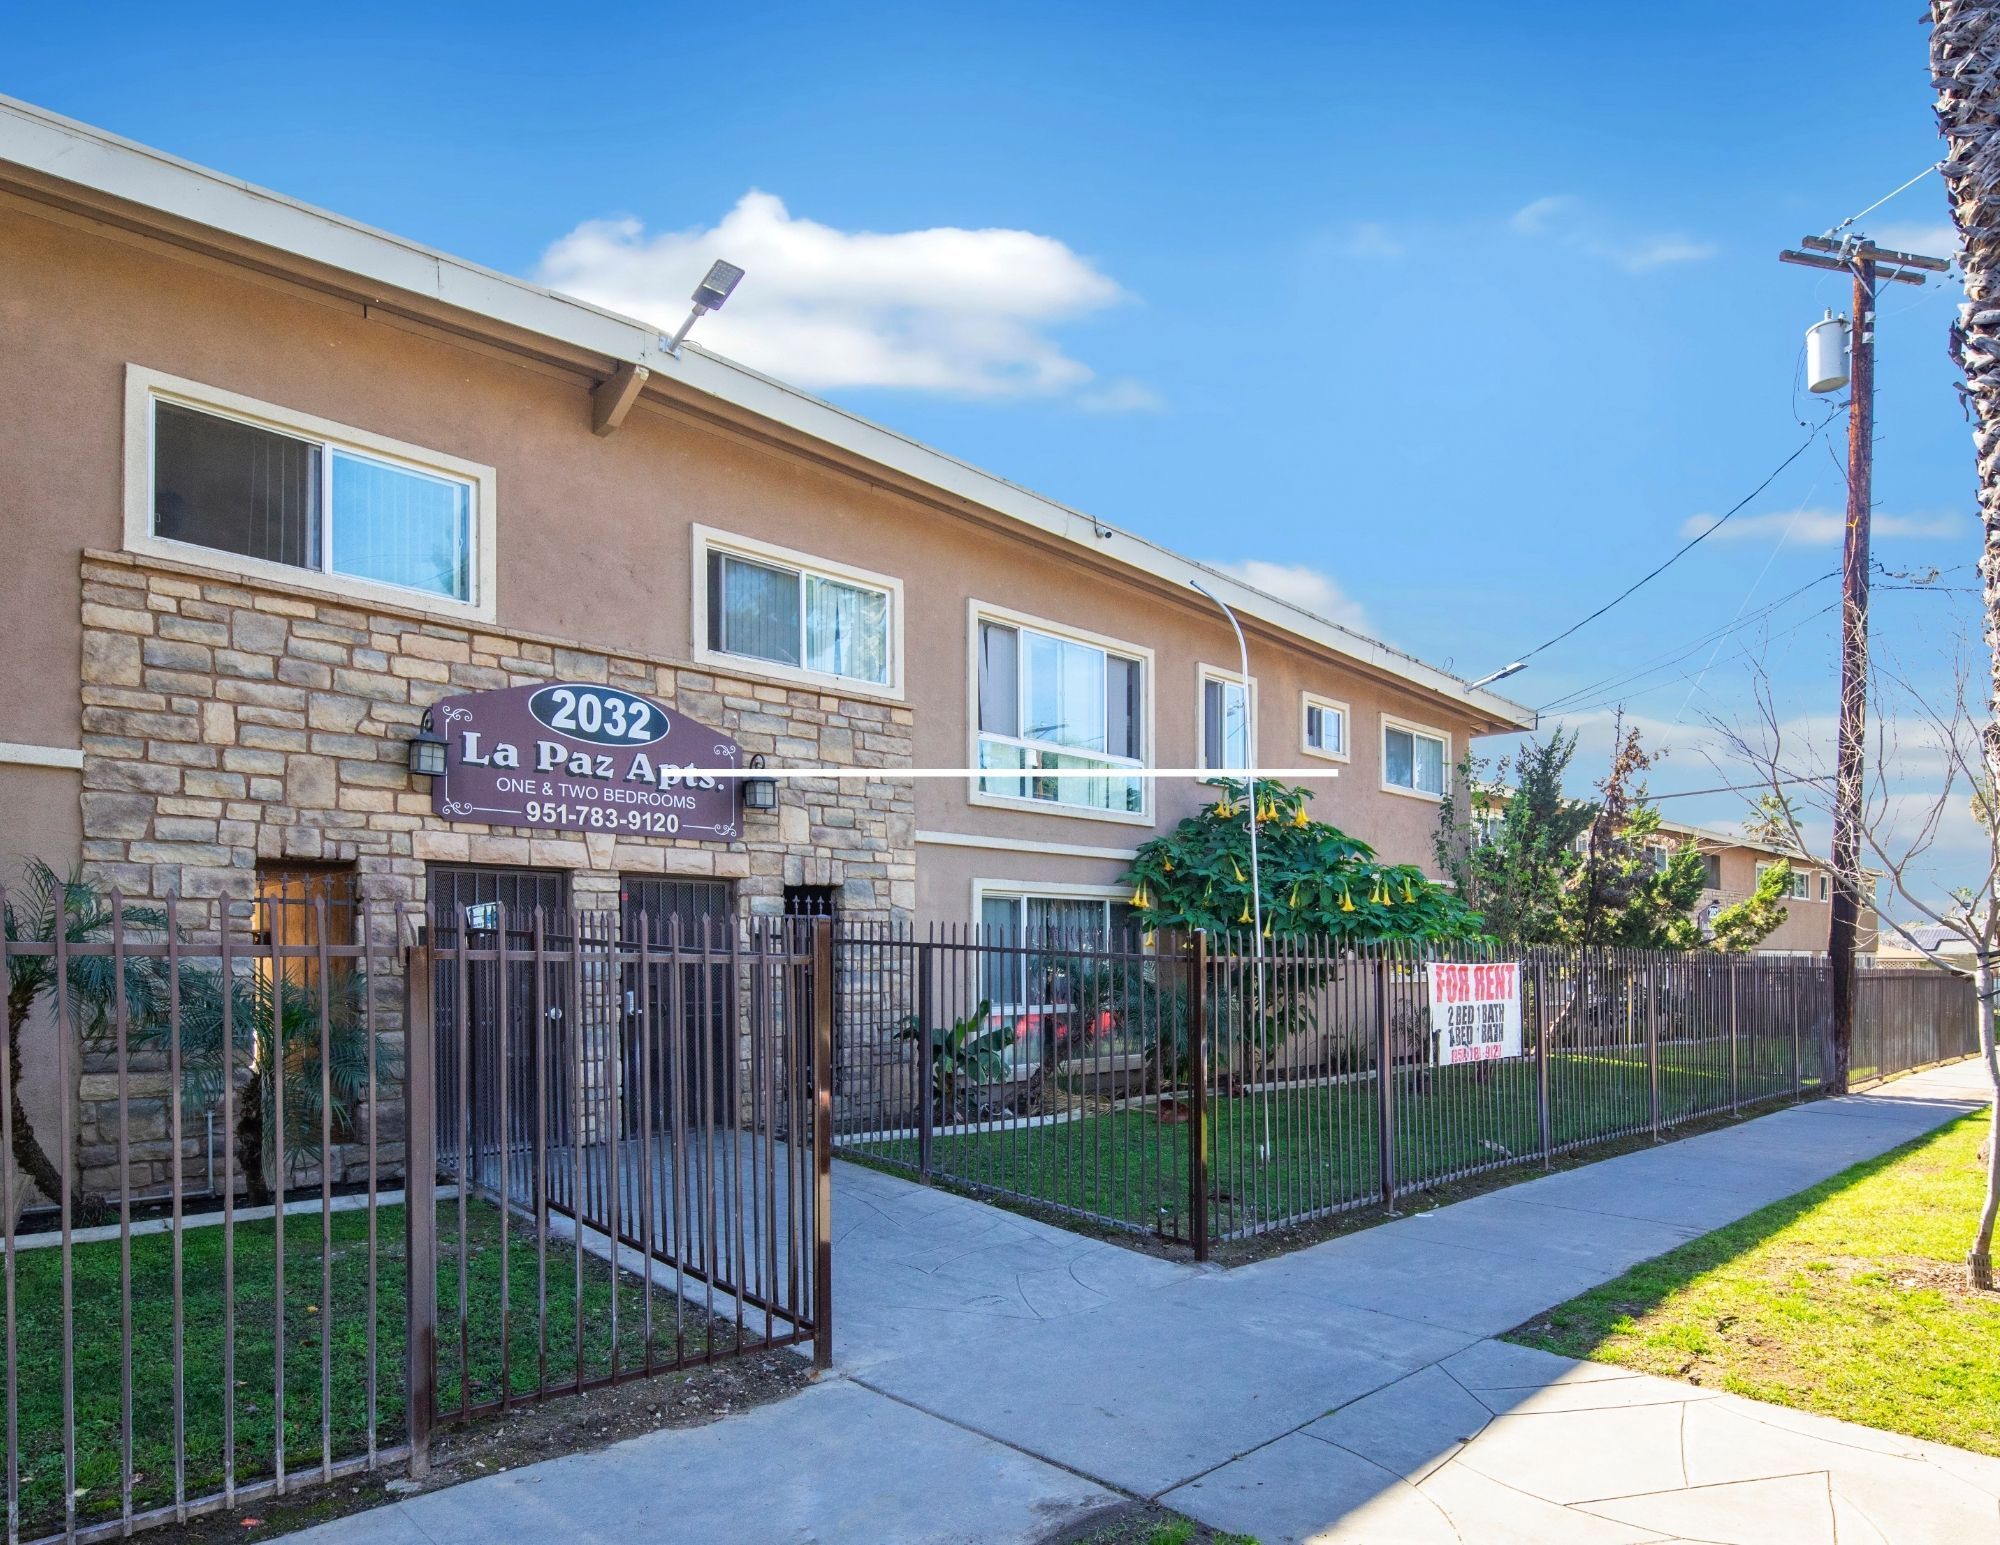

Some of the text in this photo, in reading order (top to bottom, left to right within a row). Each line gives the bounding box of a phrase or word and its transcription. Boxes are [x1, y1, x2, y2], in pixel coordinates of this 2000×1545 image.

[551, 689, 651, 741] 2032
[462, 731, 520, 769] La
[535, 740, 615, 779] Paz
[496, 777, 697, 810] ONE & TWO BEDROOMS
[526, 801, 680, 834] 951-783-9120
[1435, 964, 1515, 1004] FOR RENT
[1447, 1006, 1454, 1027] 2
[1455, 1005, 1475, 1026] BED
[1481, 1003, 1505, 1024] BATH
